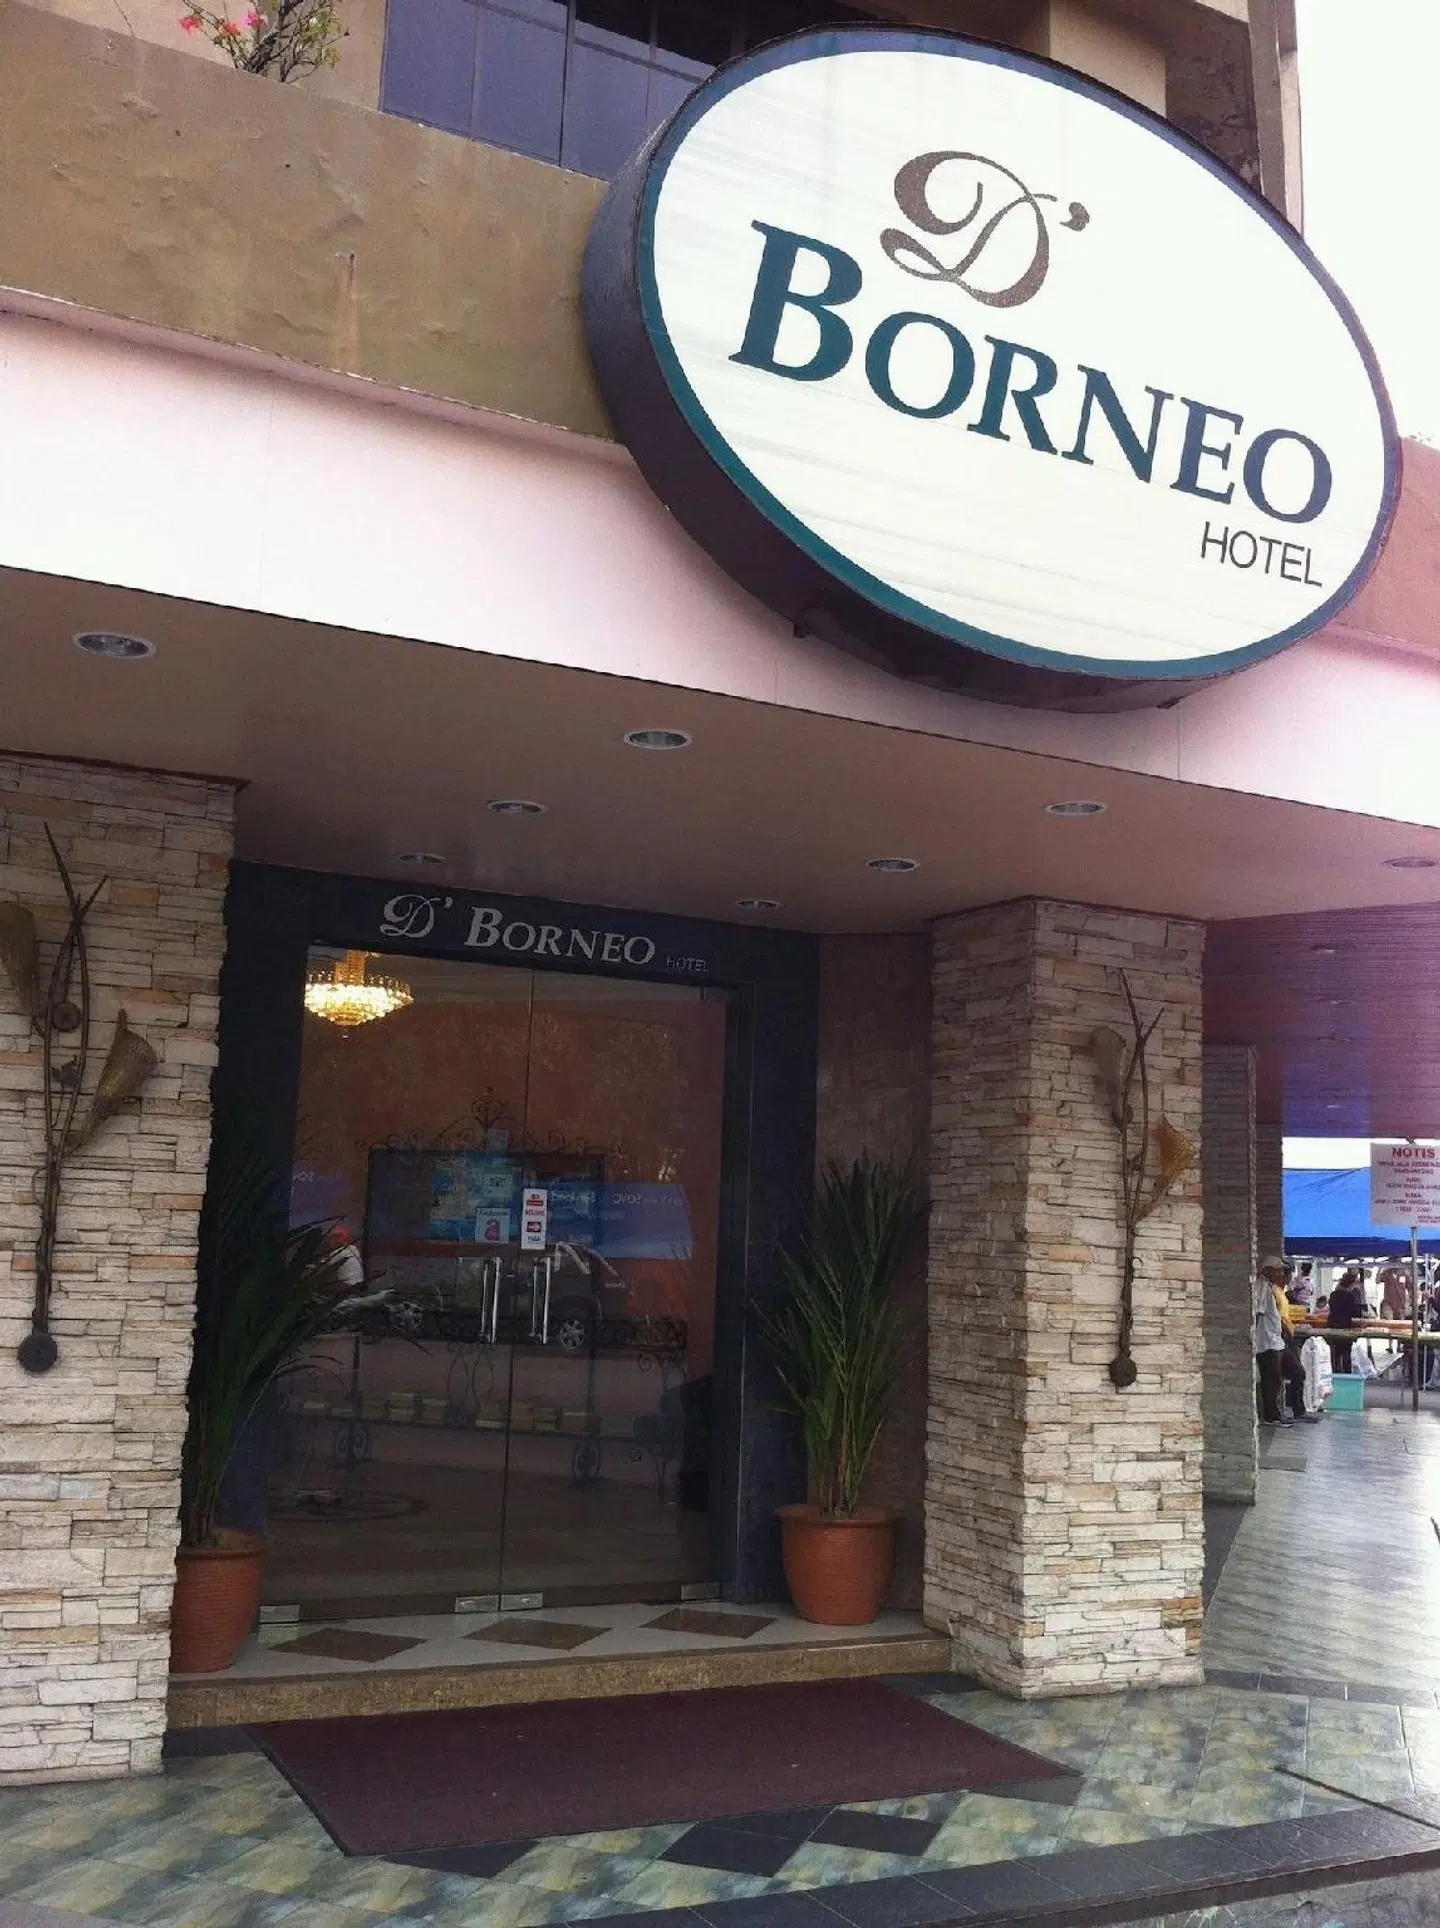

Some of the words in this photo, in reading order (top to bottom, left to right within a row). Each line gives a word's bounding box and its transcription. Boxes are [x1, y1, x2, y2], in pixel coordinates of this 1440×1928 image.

[879, 150, 1091, 309] D'
[728, 218, 1333, 525] BORNEO
[1200, 521, 1323, 588] HOTEL
[379, 893, 453, 939] D'
[464, 906, 656, 965] BORNEO
[665, 956, 710, 973] HOTEL
[1392, 1147, 1435, 1158] NOTIS
